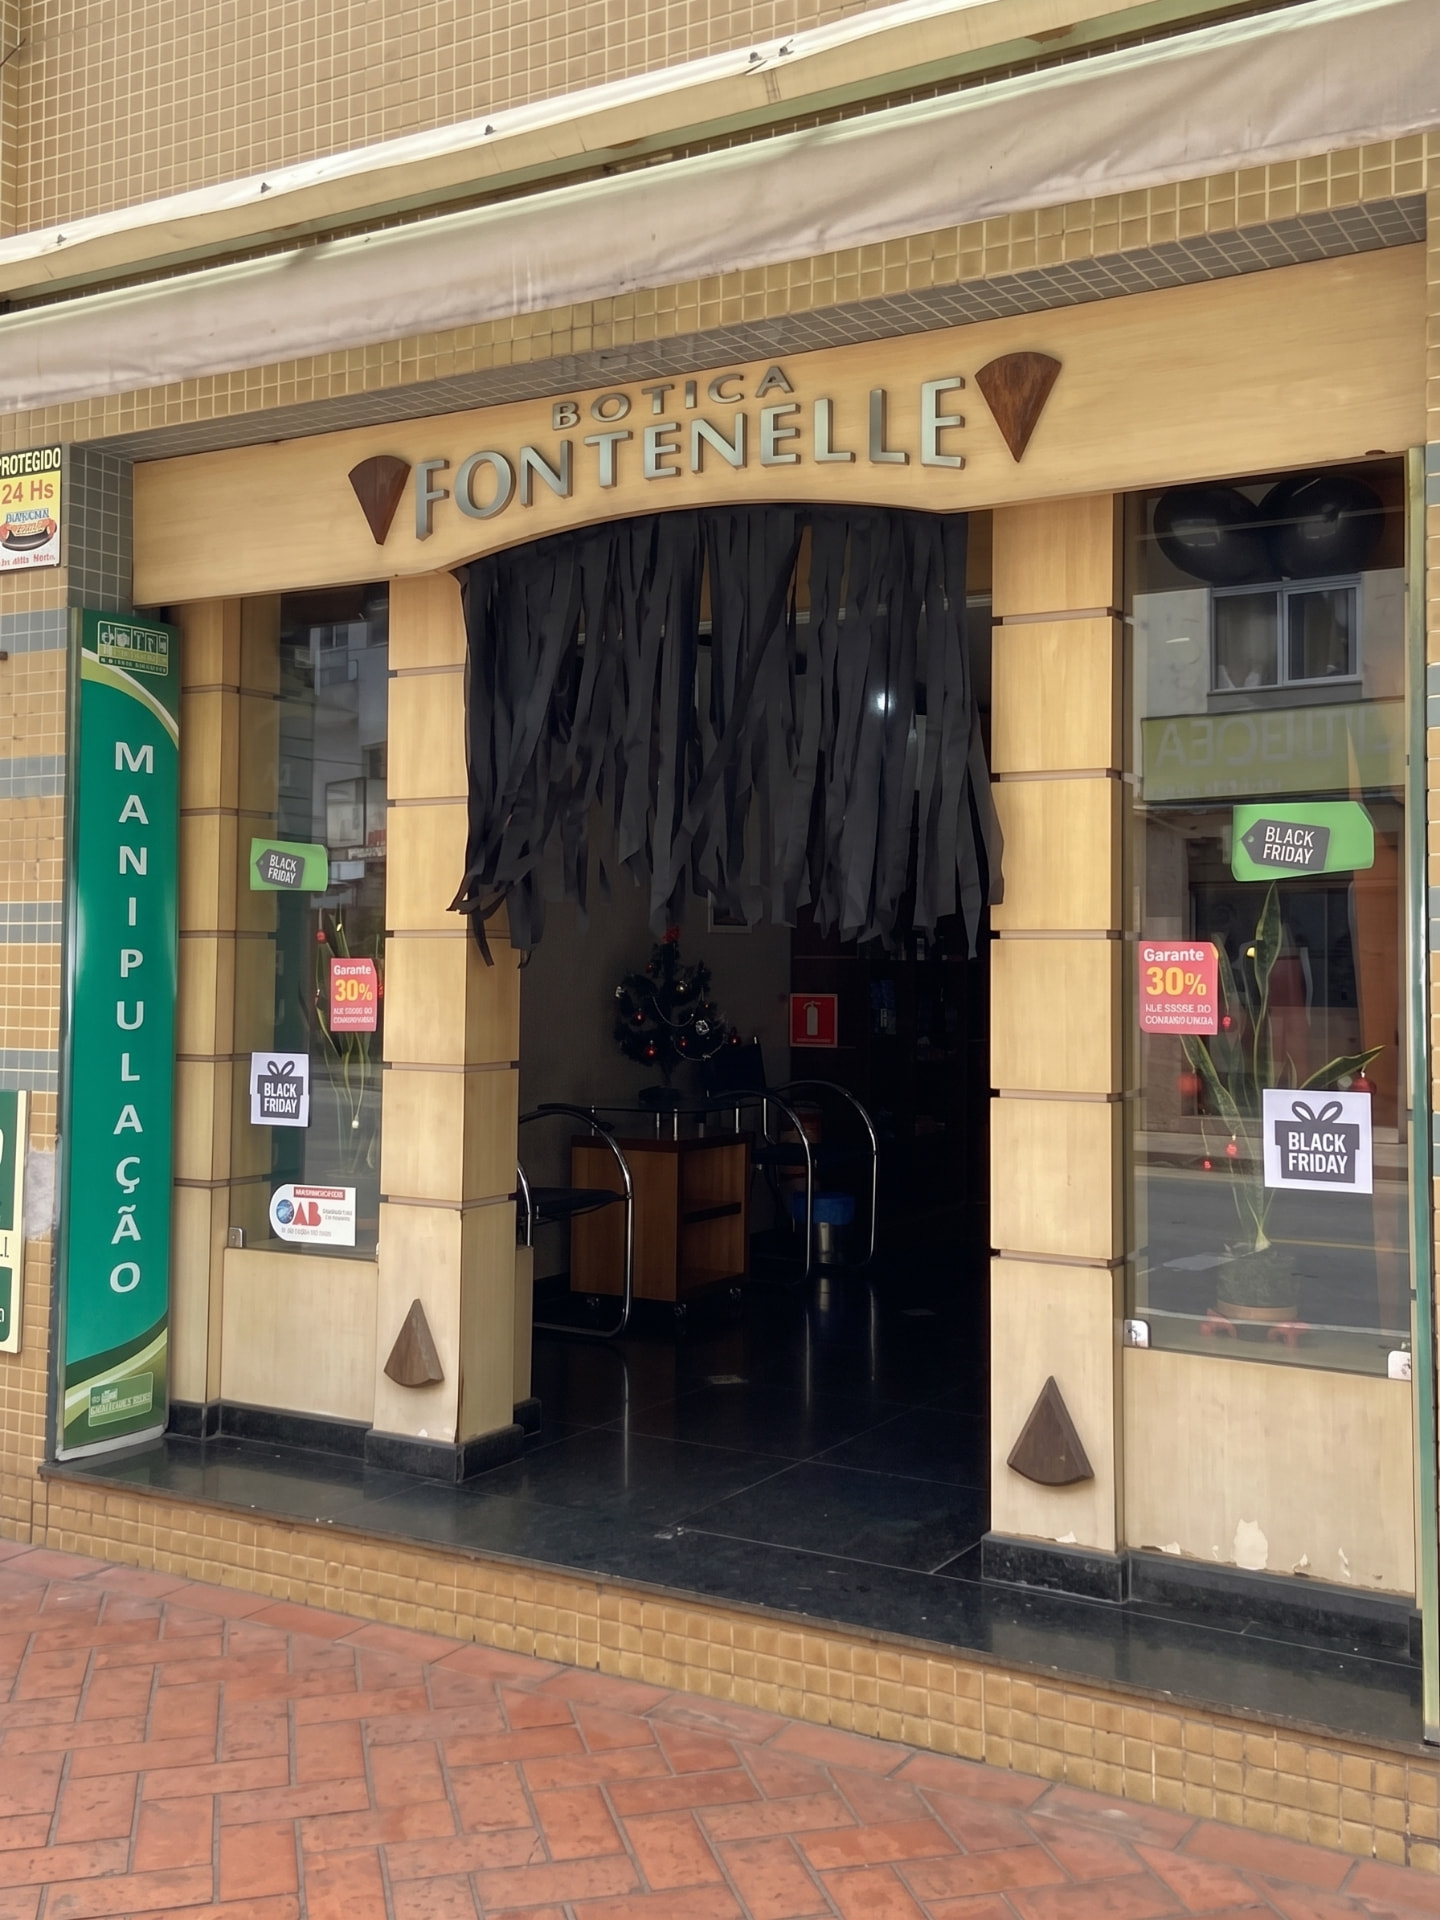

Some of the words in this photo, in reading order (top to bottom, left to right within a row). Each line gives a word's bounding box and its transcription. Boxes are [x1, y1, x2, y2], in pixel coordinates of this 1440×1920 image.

[552, 366, 795, 430] BOTICA
[0, 447, 61, 477] ROTEGIDO
[415, 377, 965, 541] FONTENELLE
[2, 481, 24, 504] 24
[31, 479, 54, 501] Hs
[1265, 826, 1315, 847] BLACK
[269, 855, 297, 871] BLACK
[1263, 844, 1314, 865] FRIDAY
[267, 867, 296, 884] FRIDAY
[1143, 948, 1205, 962] Garante
[333, 964, 372, 975] Garante
[335, 979, 373, 1001] 30%
[1146, 966, 1207, 996] 30%
[109, 741, 154, 1293] MANIPULAÇÃO
[264, 1082, 297, 1098] BLACK
[264, 1098, 297, 1113] FRIDAY
[1288, 1131, 1347, 1153] BLACK
[1288, 1152, 1348, 1174] FRIDAY
